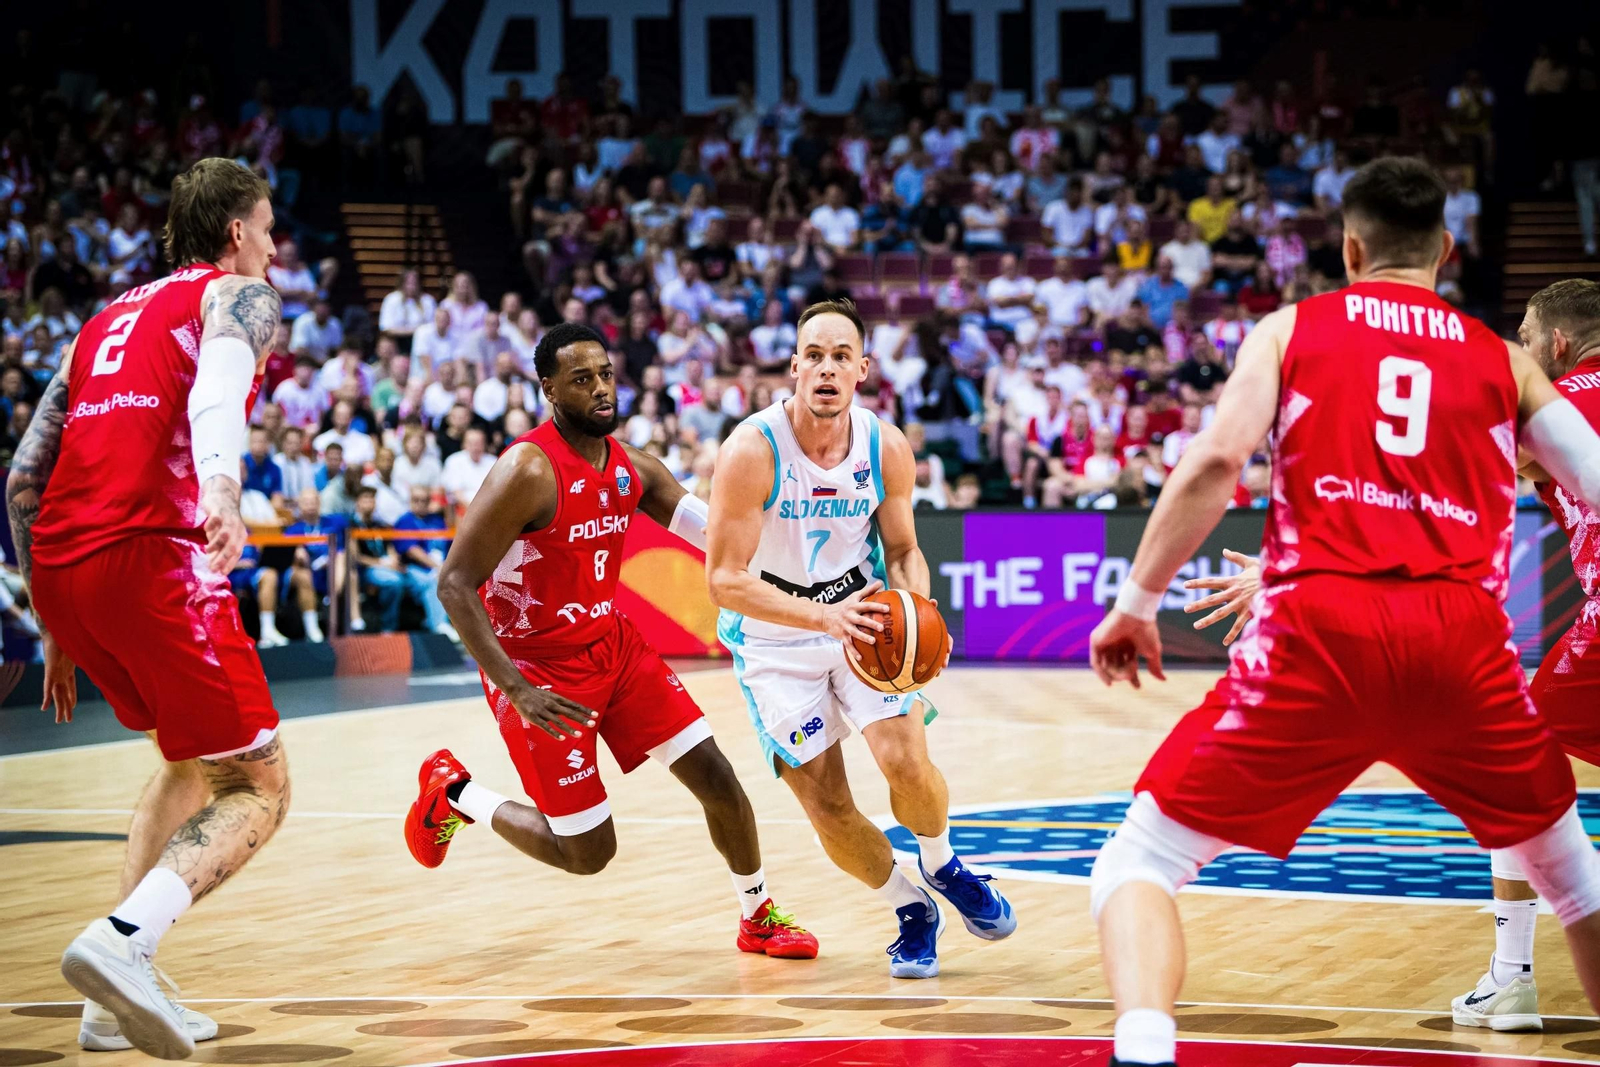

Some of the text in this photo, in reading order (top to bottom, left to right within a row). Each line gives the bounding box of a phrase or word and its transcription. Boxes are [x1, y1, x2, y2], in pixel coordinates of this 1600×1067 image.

[350, 0, 1240, 124] KATOWICE
[1344, 294, 1466, 342] PONITKA
[91, 308, 144, 377] 2
[76, 390, 160, 418] Bank Pekao
[1375, 355, 1433, 457] 9
[569, 478, 586, 494] 4F
[779, 498, 870, 519] SLOVENIJA
[1362, 481, 1478, 527] Bank Pekao
[594, 550, 609, 582] 8
[806, 529, 831, 573] 7
[939, 556, 1044, 611] THE
[883, 694, 899, 704] KZS
